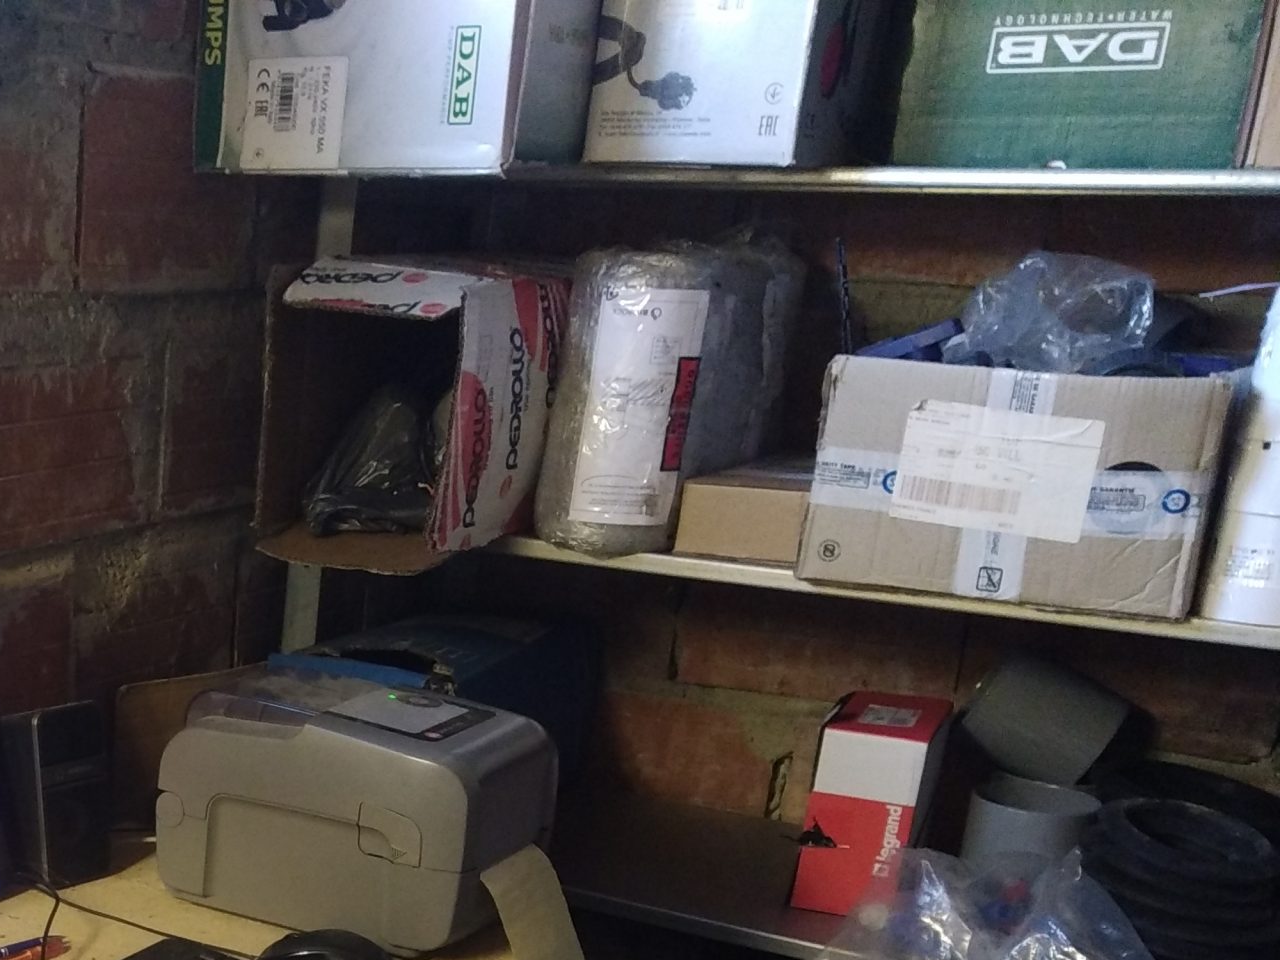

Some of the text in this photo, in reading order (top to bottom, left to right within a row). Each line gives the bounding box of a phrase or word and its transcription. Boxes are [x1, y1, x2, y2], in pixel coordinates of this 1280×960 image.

[204, 0, 224, 65] MPS
[997, 31, 1160, 64] DAB
[453, 32, 477, 119] DAB
[505, 326, 528, 471] PEDROLLO
[462, 388, 487, 529] PEDROLLO
[876, 804, 903, 862] legrand
